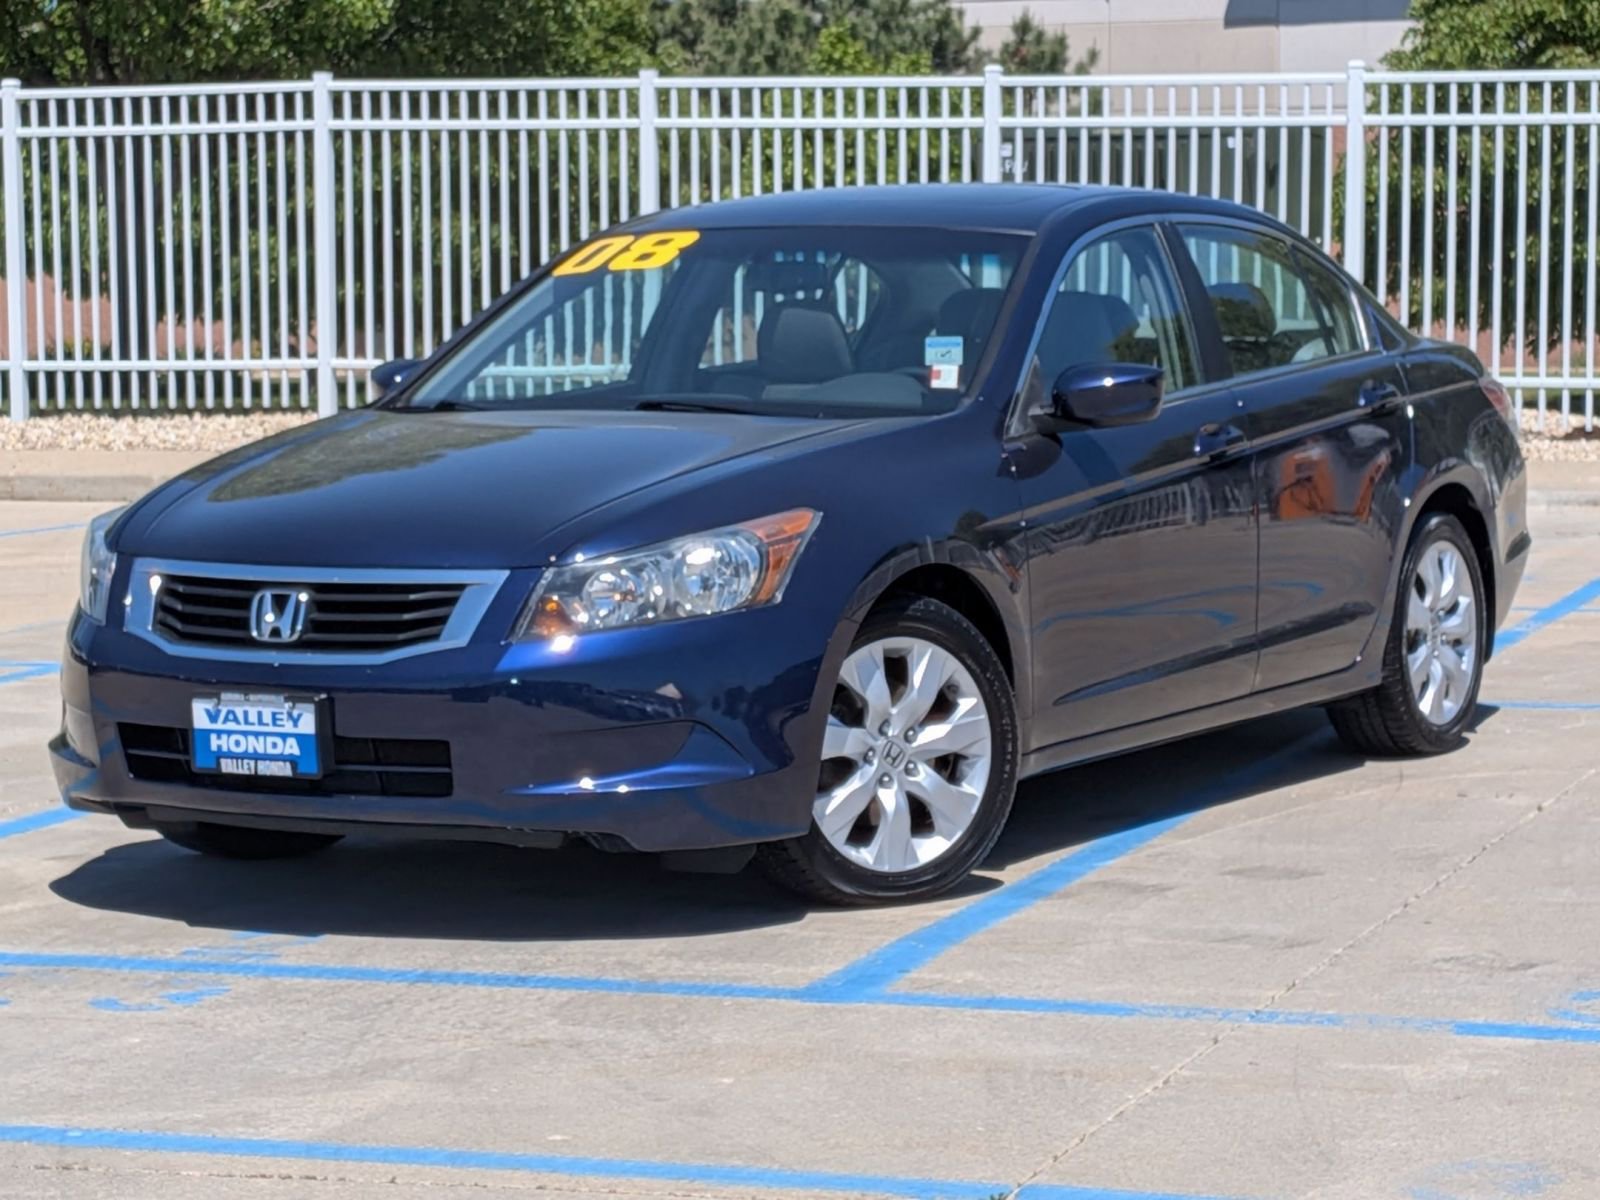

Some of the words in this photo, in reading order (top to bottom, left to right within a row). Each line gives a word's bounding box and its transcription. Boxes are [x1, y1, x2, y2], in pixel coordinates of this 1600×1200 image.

[552, 230, 701, 277] 08
[203, 707, 304, 729] VALLEY
[209, 732, 301, 757] HONDA
